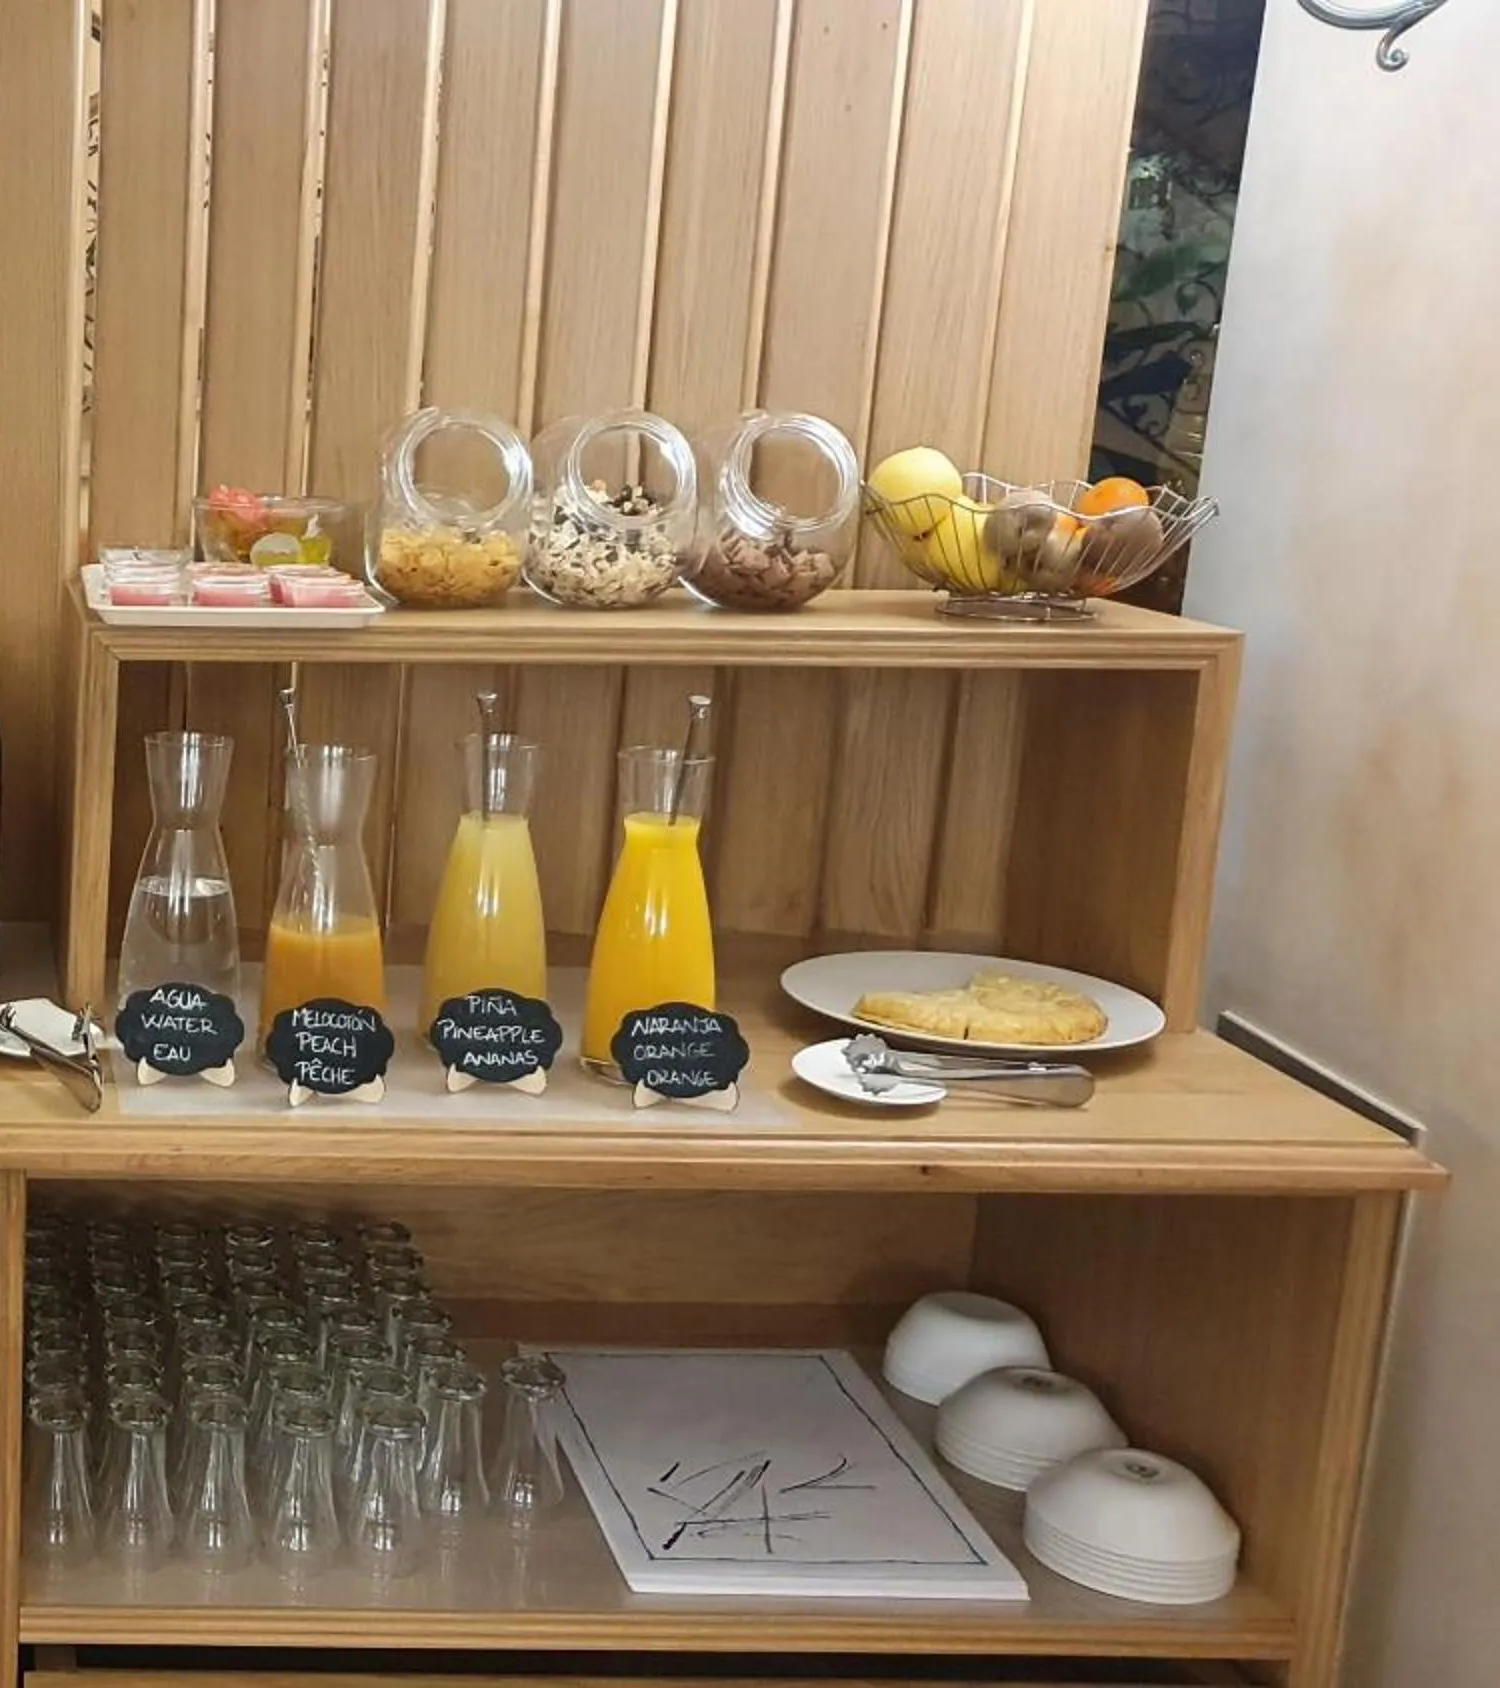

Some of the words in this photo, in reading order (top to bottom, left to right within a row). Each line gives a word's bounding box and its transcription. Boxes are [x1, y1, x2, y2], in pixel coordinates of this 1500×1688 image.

[149, 988, 207, 1011] AGUA
[466, 995, 517, 1016] PIÑA
[141, 1013, 218, 1035] WATER
[291, 1007, 376, 1032] MELOCOTÓN
[631, 1016, 722, 1037] NARANJA
[437, 1018, 545, 1044] PINEAPPLE
[153, 1043, 191, 1062] EAU
[295, 1031, 356, 1058] PEACH
[633, 1041, 715, 1061] ORANGE
[463, 1049, 539, 1066] ANANAS
[294, 1057, 355, 1085] PÊCHE
[646, 1069, 718, 1087] ORANGE
